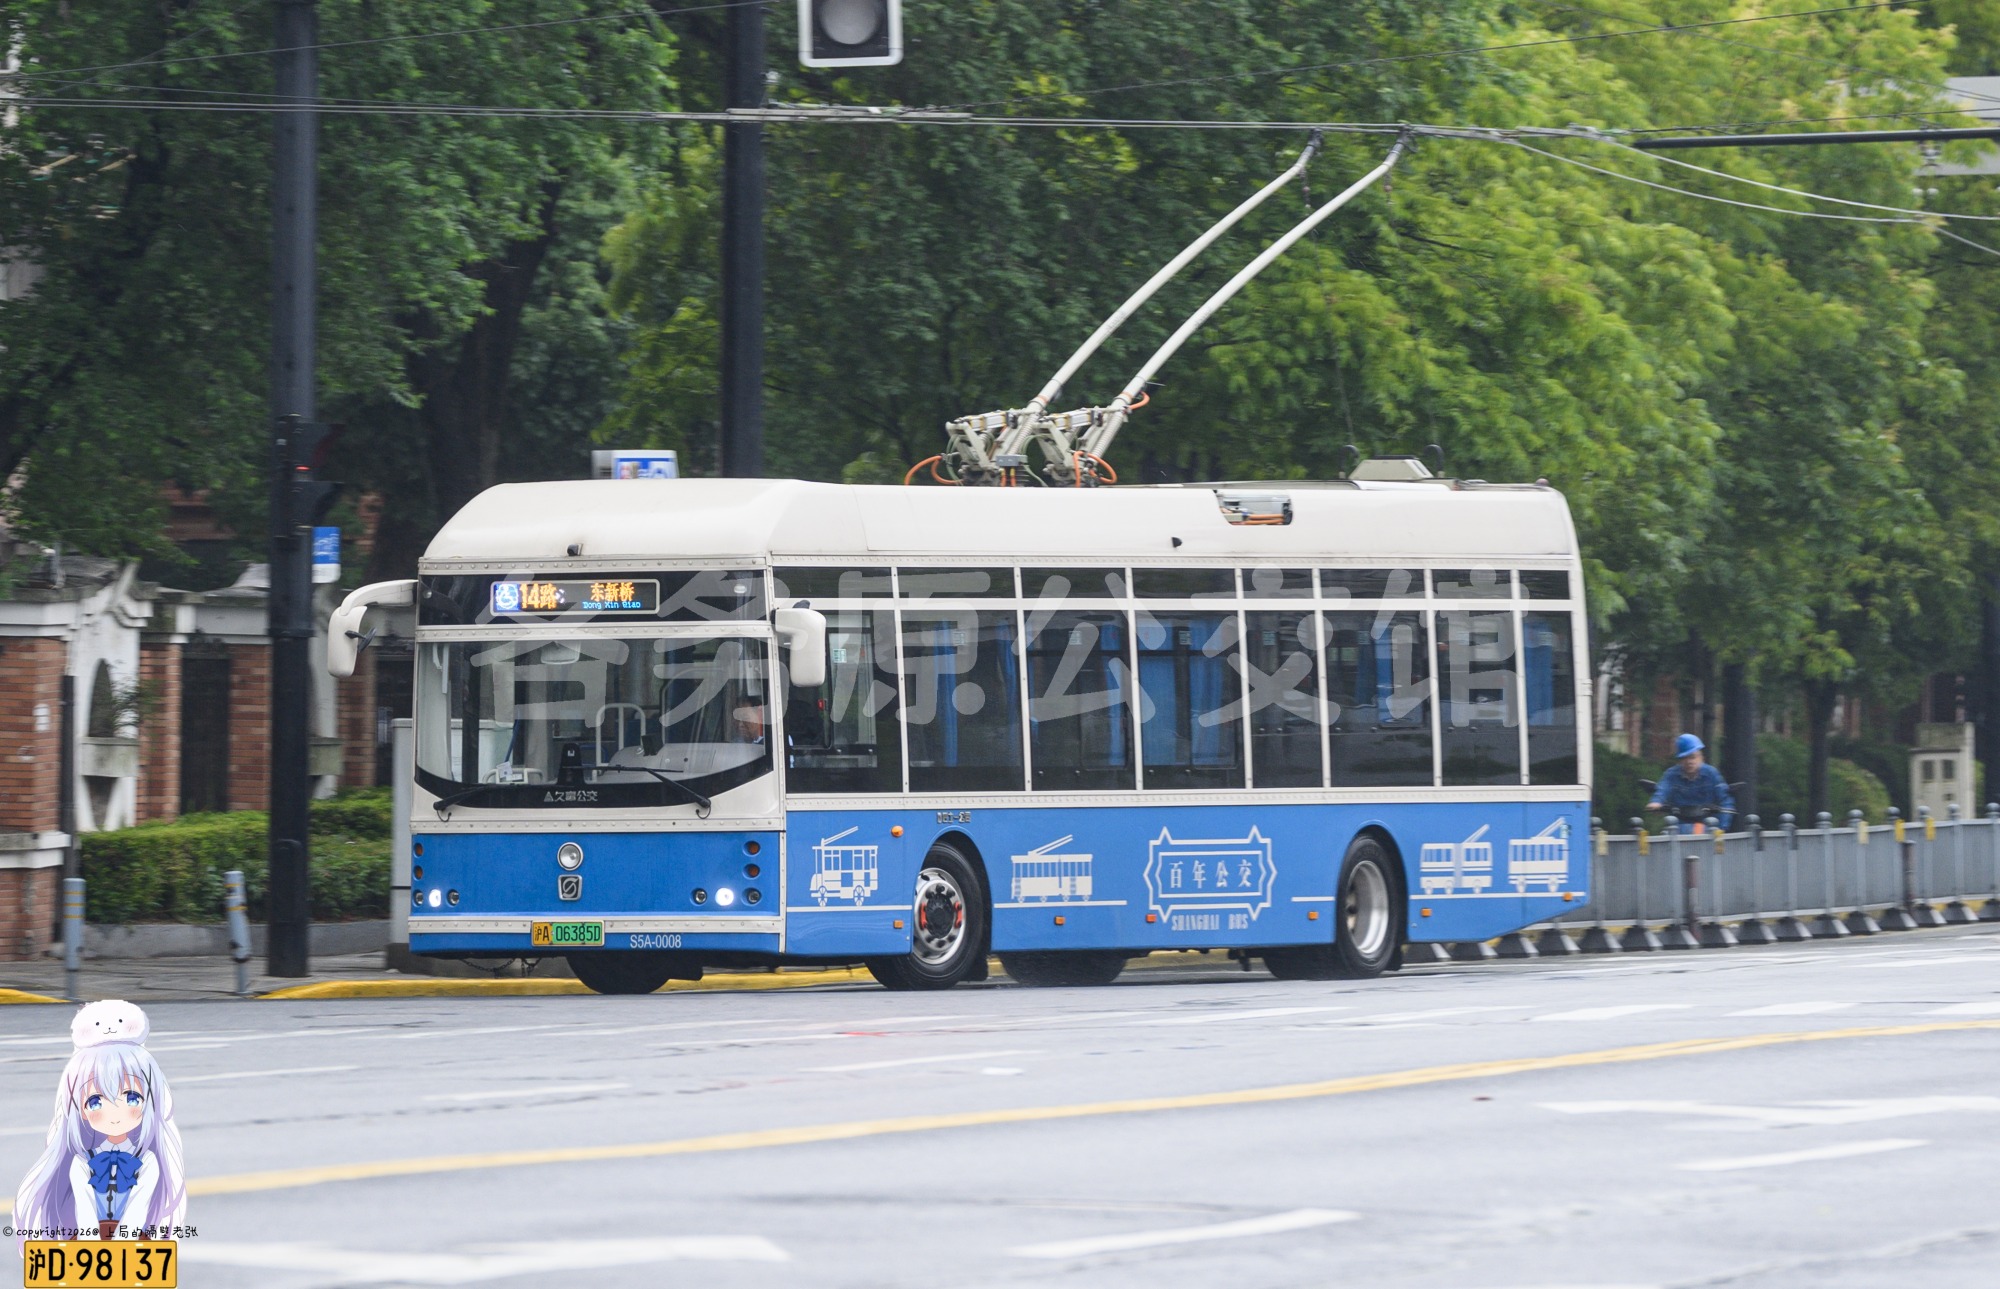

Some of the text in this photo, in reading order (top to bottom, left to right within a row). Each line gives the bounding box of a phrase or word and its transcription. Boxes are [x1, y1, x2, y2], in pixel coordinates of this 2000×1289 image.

[520, 583, 557, 609] 14路
[590, 582, 635, 602] 东新桥
[582, 601, 641, 610] Dong Xin Qiao
[1169, 859, 1253, 889] 百年公交
[1228, 913, 1249, 930] BUS
[630, 934, 682, 949] S5A-0008
